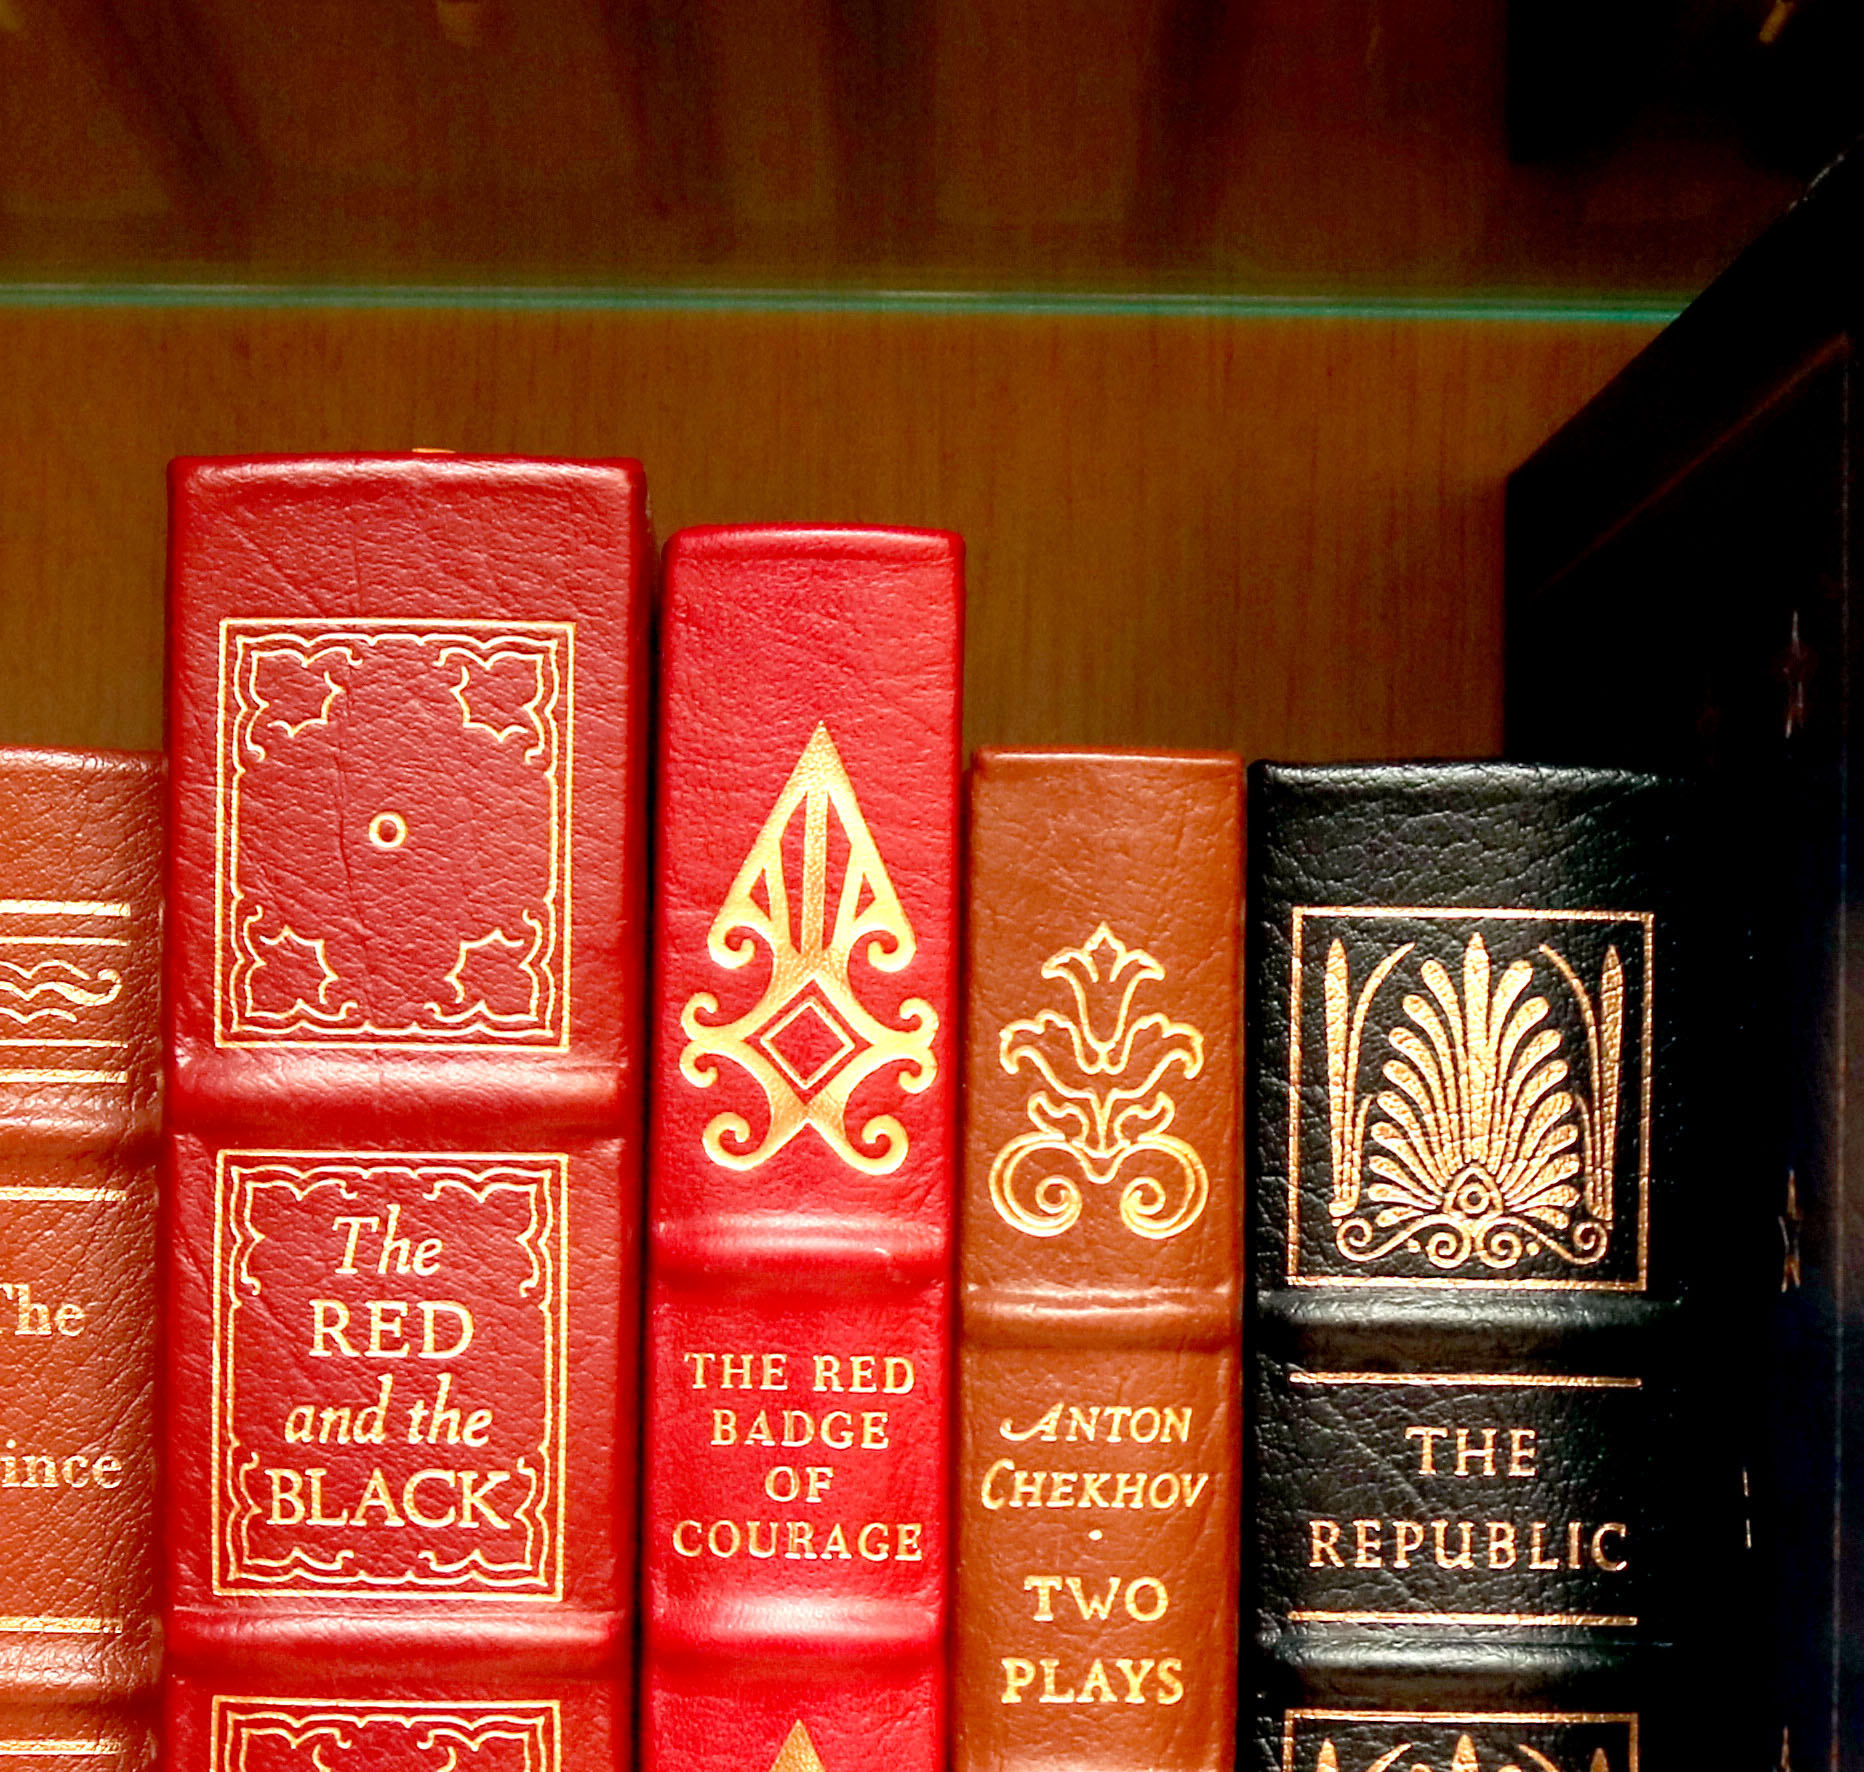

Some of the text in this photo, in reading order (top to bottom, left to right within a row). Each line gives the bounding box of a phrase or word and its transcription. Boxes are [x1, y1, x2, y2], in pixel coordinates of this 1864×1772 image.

[333, 1205, 442, 1275] The
[309, 1300, 474, 1358] RED
[683, 1352, 916, 1396] THE RED
[285, 1374, 492, 1447] and the
[712, 1409, 890, 1449] BADGE
[999, 1403, 1192, 1444] ANTON
[1405, 1425, 1537, 1476] THE
[266, 1468, 513, 1530] BLACK
[765, 1466, 833, 1502] OF
[980, 1458, 1208, 1511] CHEKHOV
[671, 1520, 924, 1563] COURAGE
[1308, 1521, 1628, 1572] REPUBLIC
[1024, 1576, 1168, 1622] TWO
[1001, 1656, 1183, 1705] PLAYS
